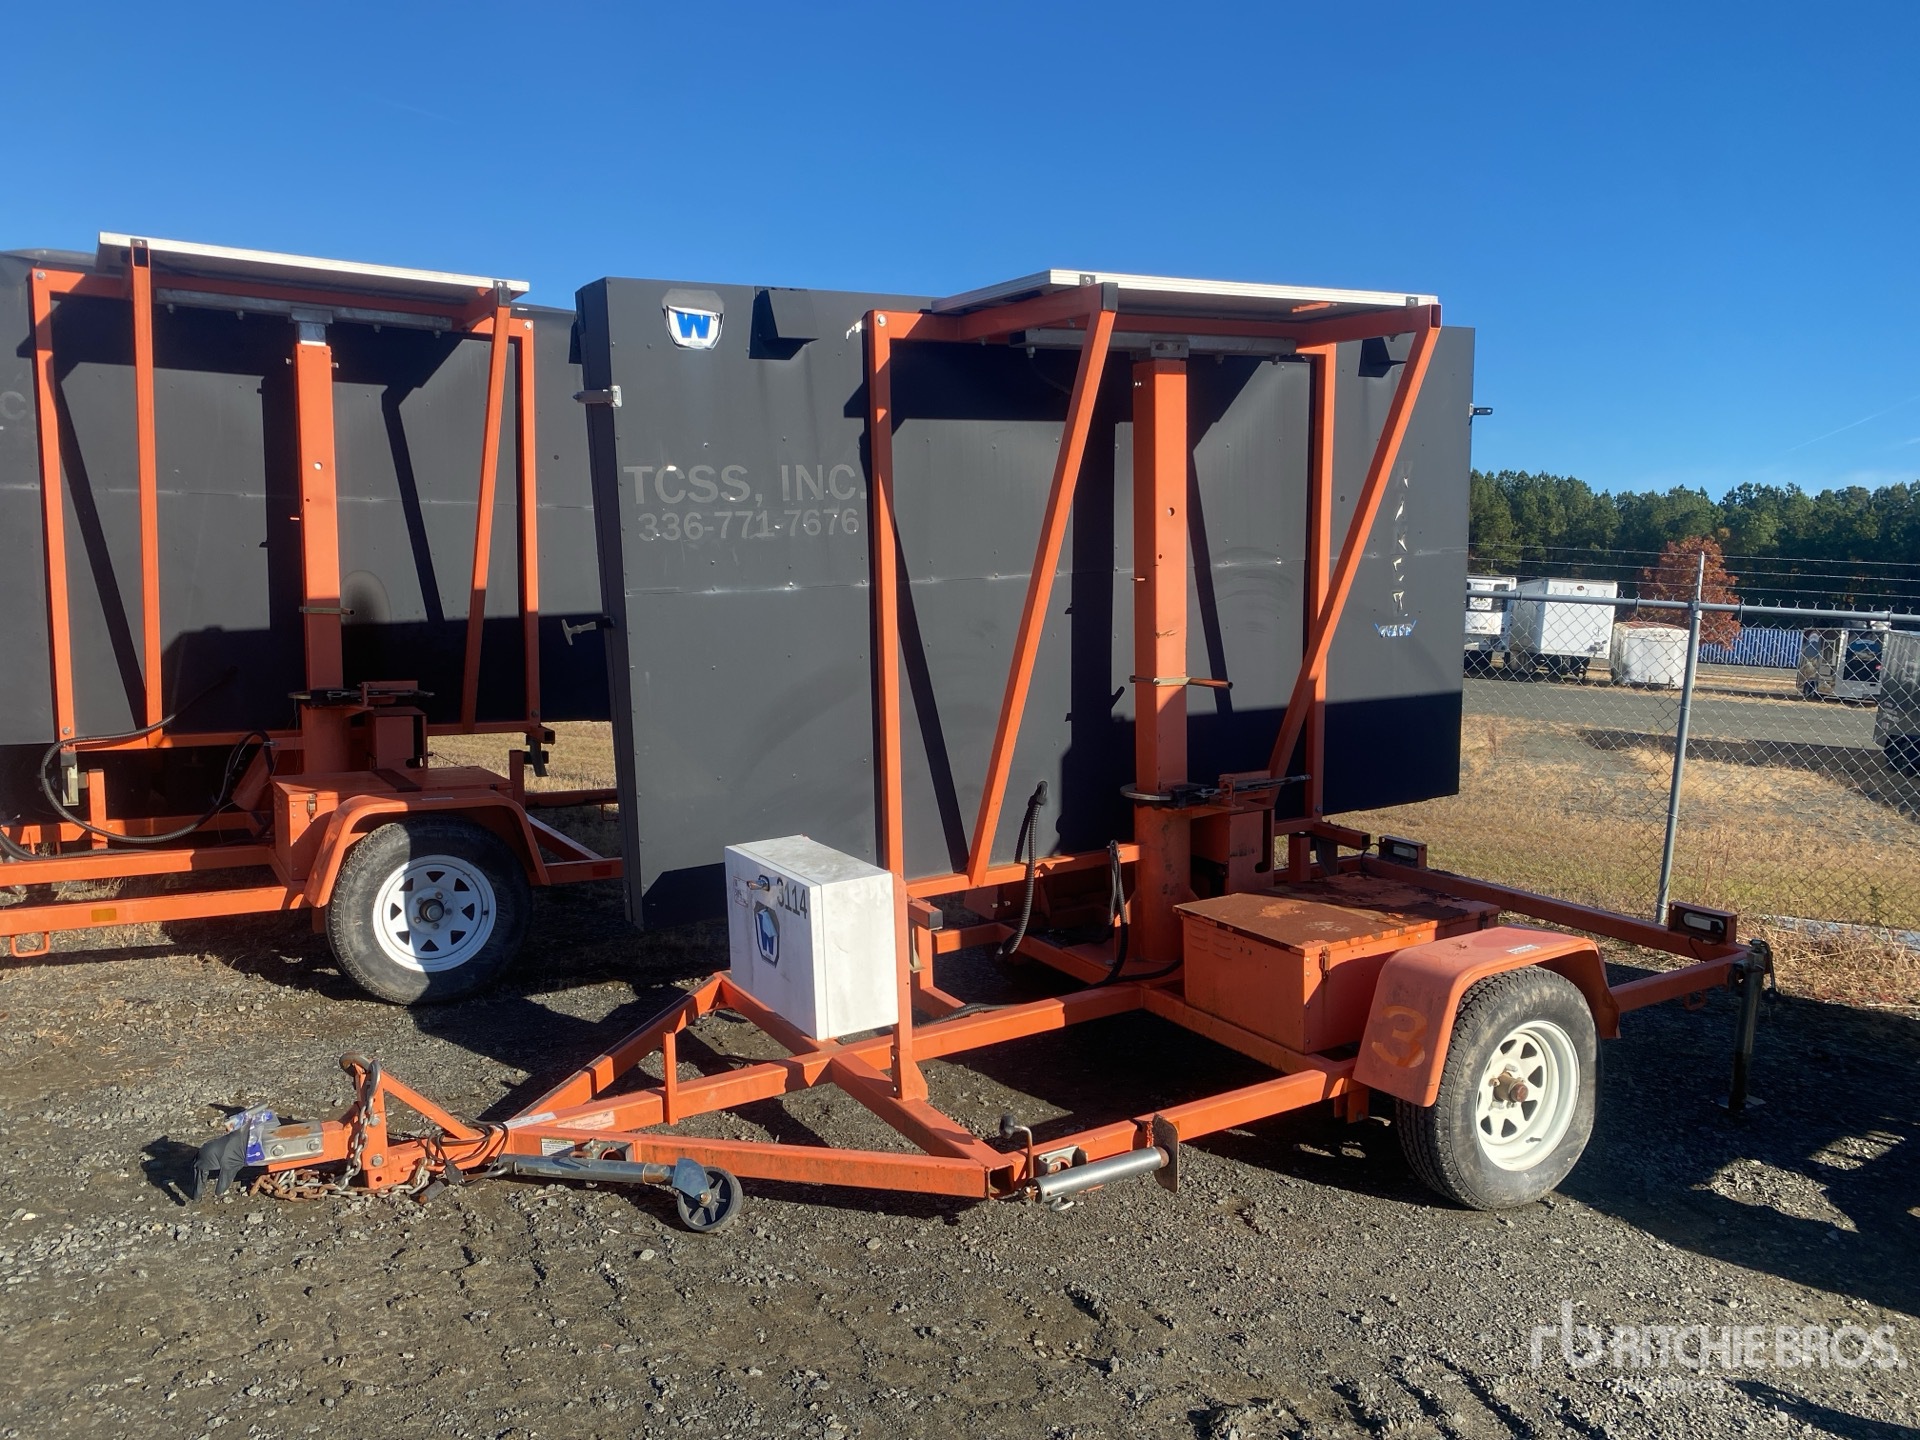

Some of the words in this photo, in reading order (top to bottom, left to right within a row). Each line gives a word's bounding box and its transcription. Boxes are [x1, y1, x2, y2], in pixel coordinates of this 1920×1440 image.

[675, 311, 711, 339] W
[623, 464, 763, 508] TCSS,
[781, 464, 867, 501] INC.
[638, 508, 860, 542] 336-771-7676
[777, 877, 808, 919] 3114
[1371, 1005, 1428, 1068] 3
